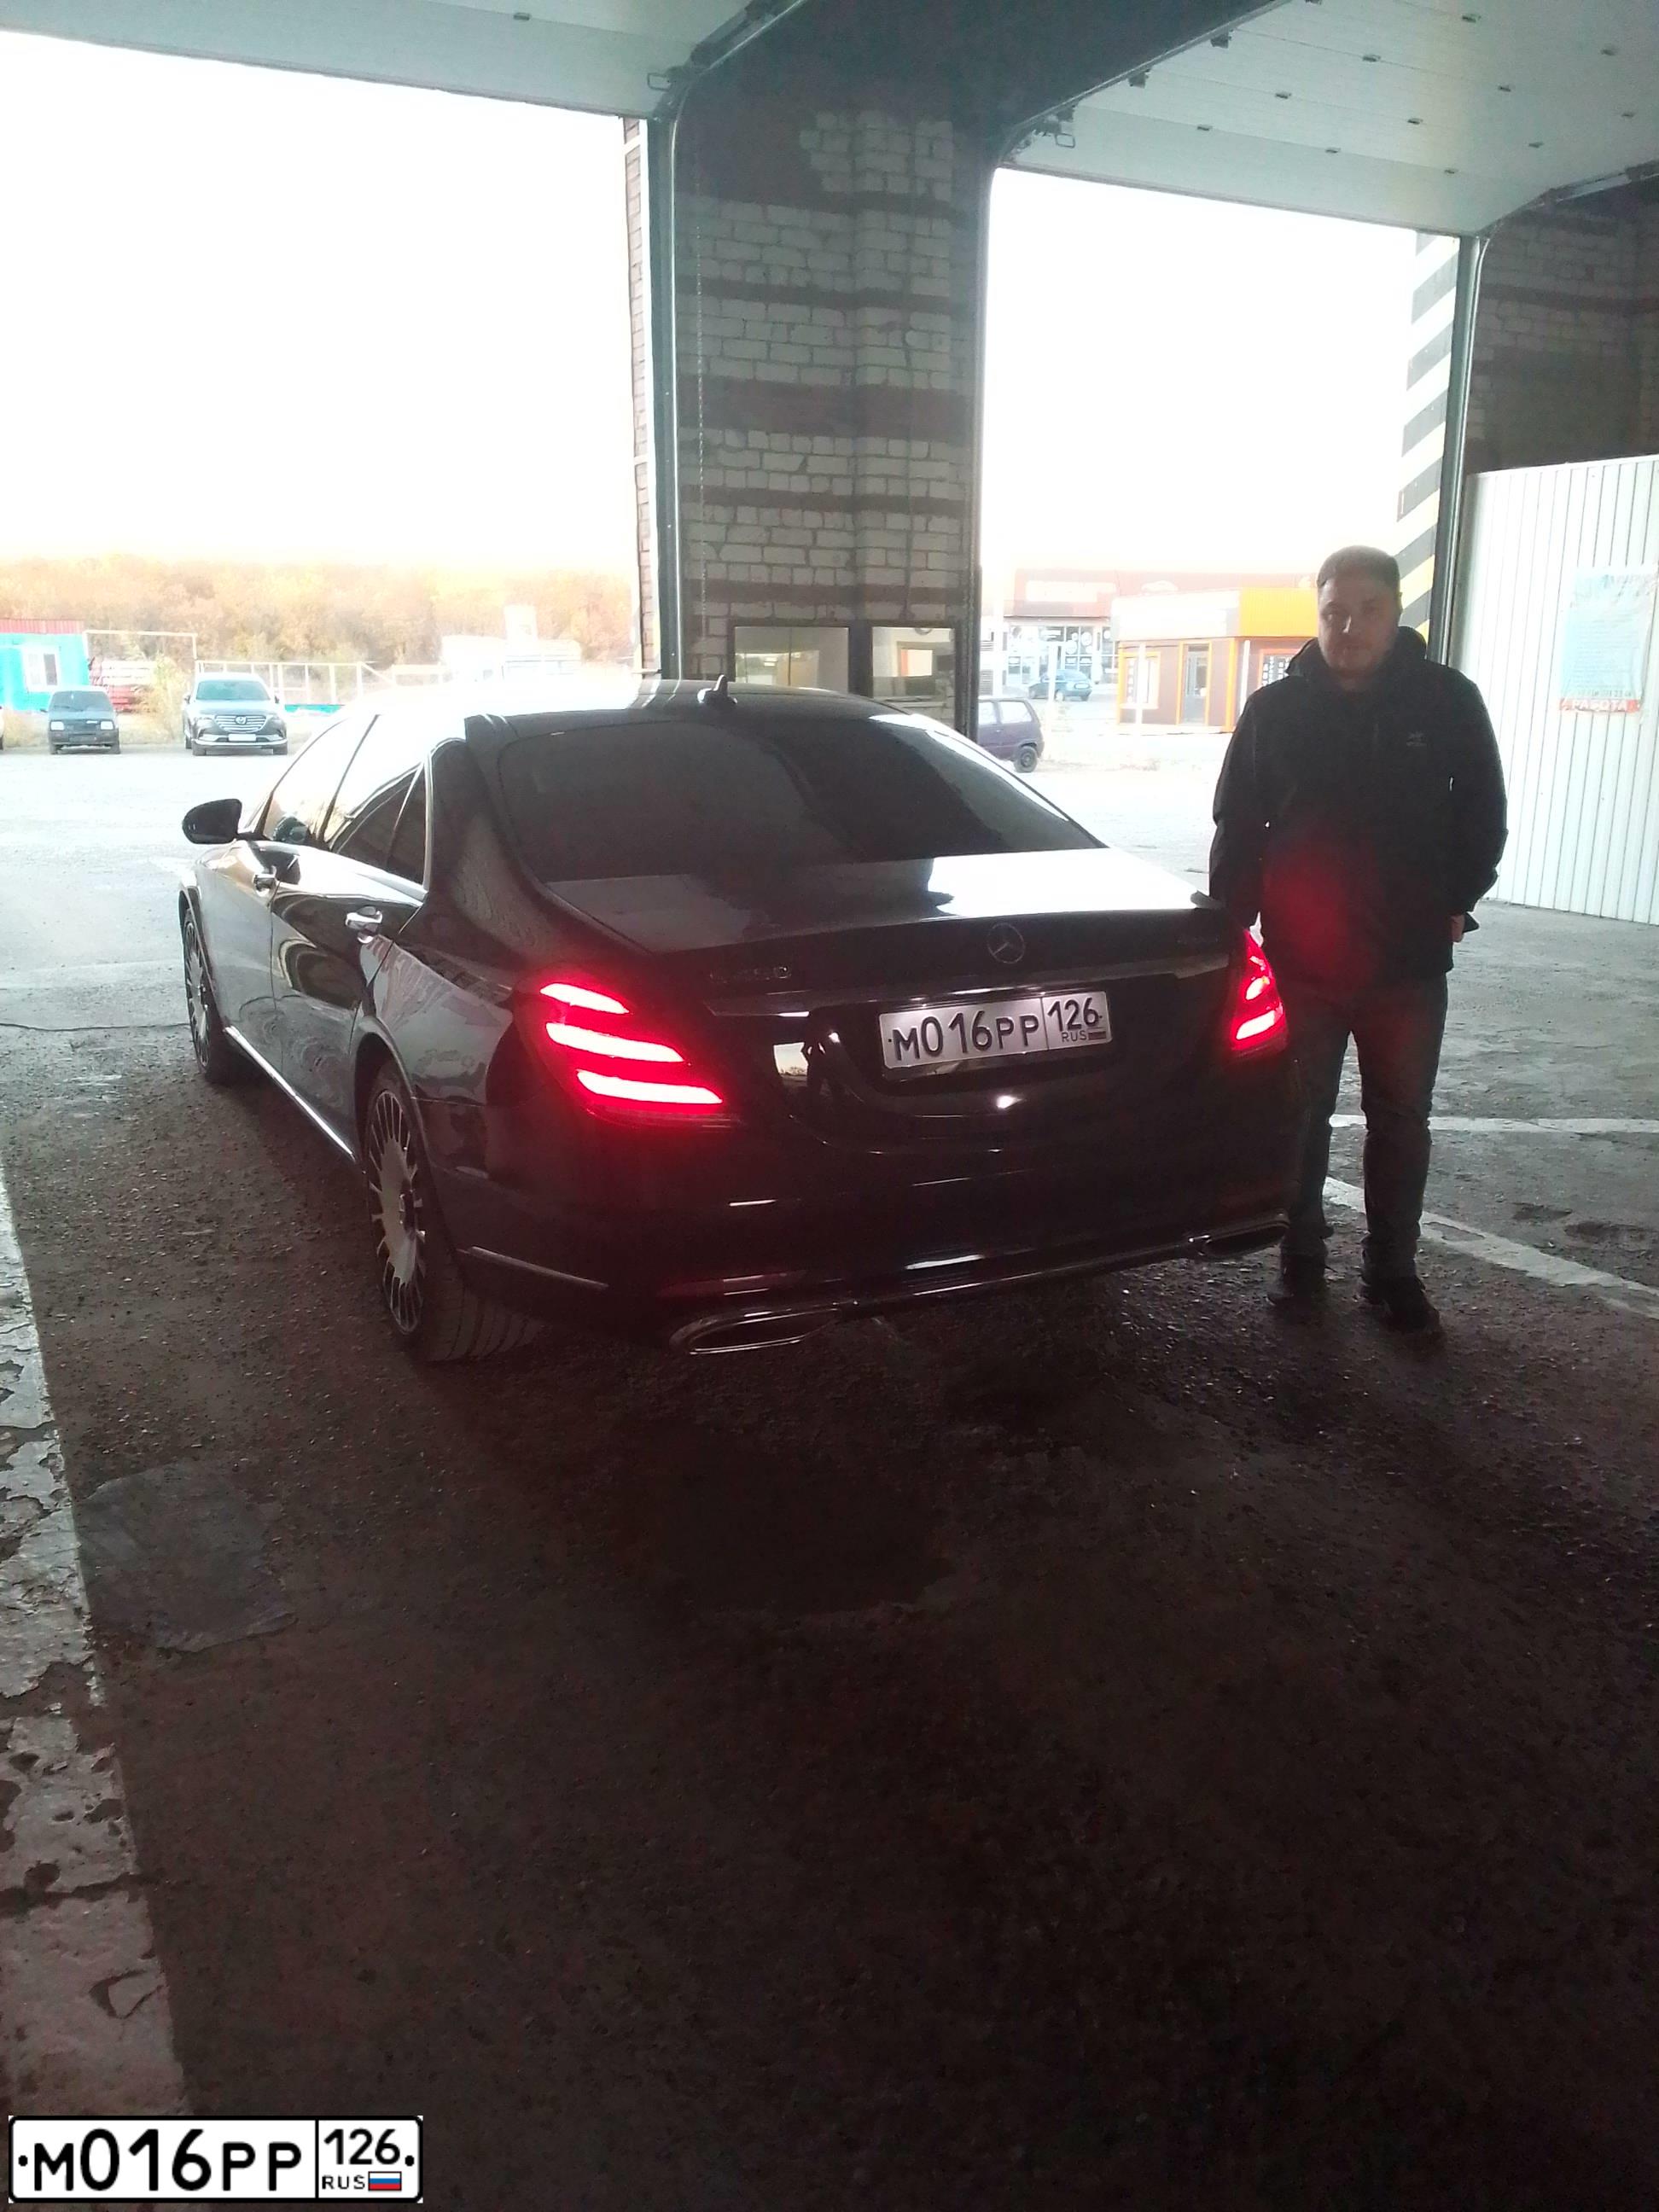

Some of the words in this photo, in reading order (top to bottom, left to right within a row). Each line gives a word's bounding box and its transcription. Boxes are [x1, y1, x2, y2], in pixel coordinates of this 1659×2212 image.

[892, 1010, 1040, 1061] M016PP
[1047, 998, 1100, 1032] 126
[1061, 1030, 1087, 1043] RUS
